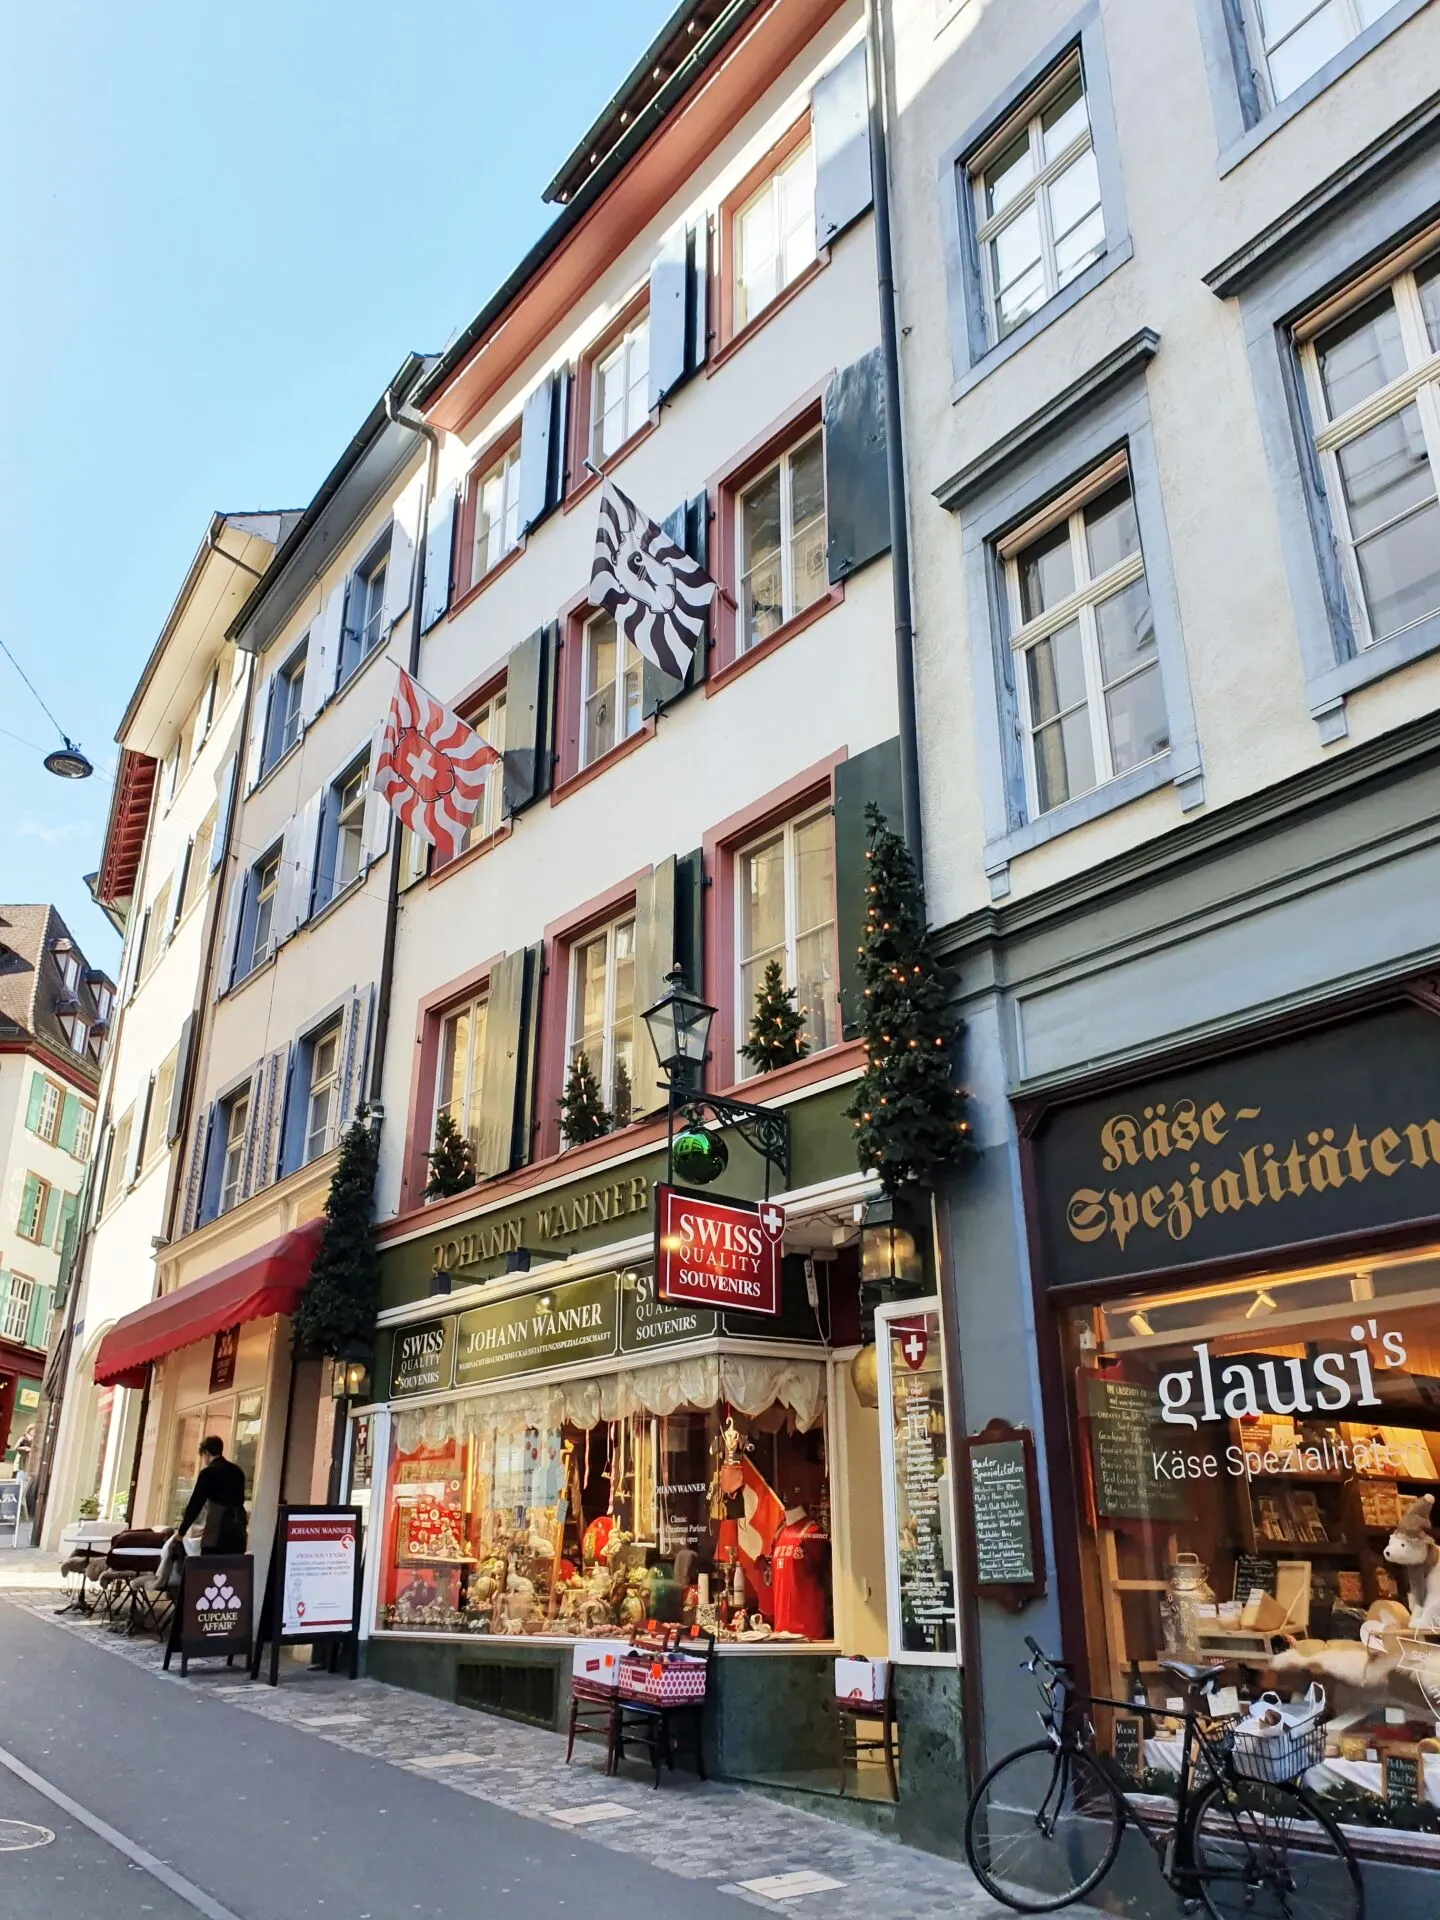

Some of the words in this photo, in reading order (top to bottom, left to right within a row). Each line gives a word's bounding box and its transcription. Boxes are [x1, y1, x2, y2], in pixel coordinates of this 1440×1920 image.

[1066, 1119, 1440, 1252] Spezialitäten
[432, 1216, 525, 1273] JOHANN
[536, 1176, 649, 1241] WANNER
[680, 1214, 762, 1256] SWISS
[679, 1245, 760, 1273] QUALITY
[679, 1268, 760, 1297] SOUVENIRS
[467, 1319, 528, 1354] JOHANN
[532, 1303, 603, 1338] WANNER
[636, 1314, 697, 1341] SOUVENIRS
[402, 1329, 444, 1359] SWISS
[401, 1353, 440, 1374] QUALITY
[1158, 1319, 1407, 1431] glausi's
[400, 1371, 440, 1390] SOUVENIRS
[1152, 1450, 1218, 1481] Käse
[677, 1483, 706, 1493] WANNER
[290, 1526, 320, 1536] JOHANN
[322, 1526, 352, 1535] WANNER
[197, 1612, 239, 1622] CUPCAKE
[202, 1621, 233, 1631] AFFAIR
